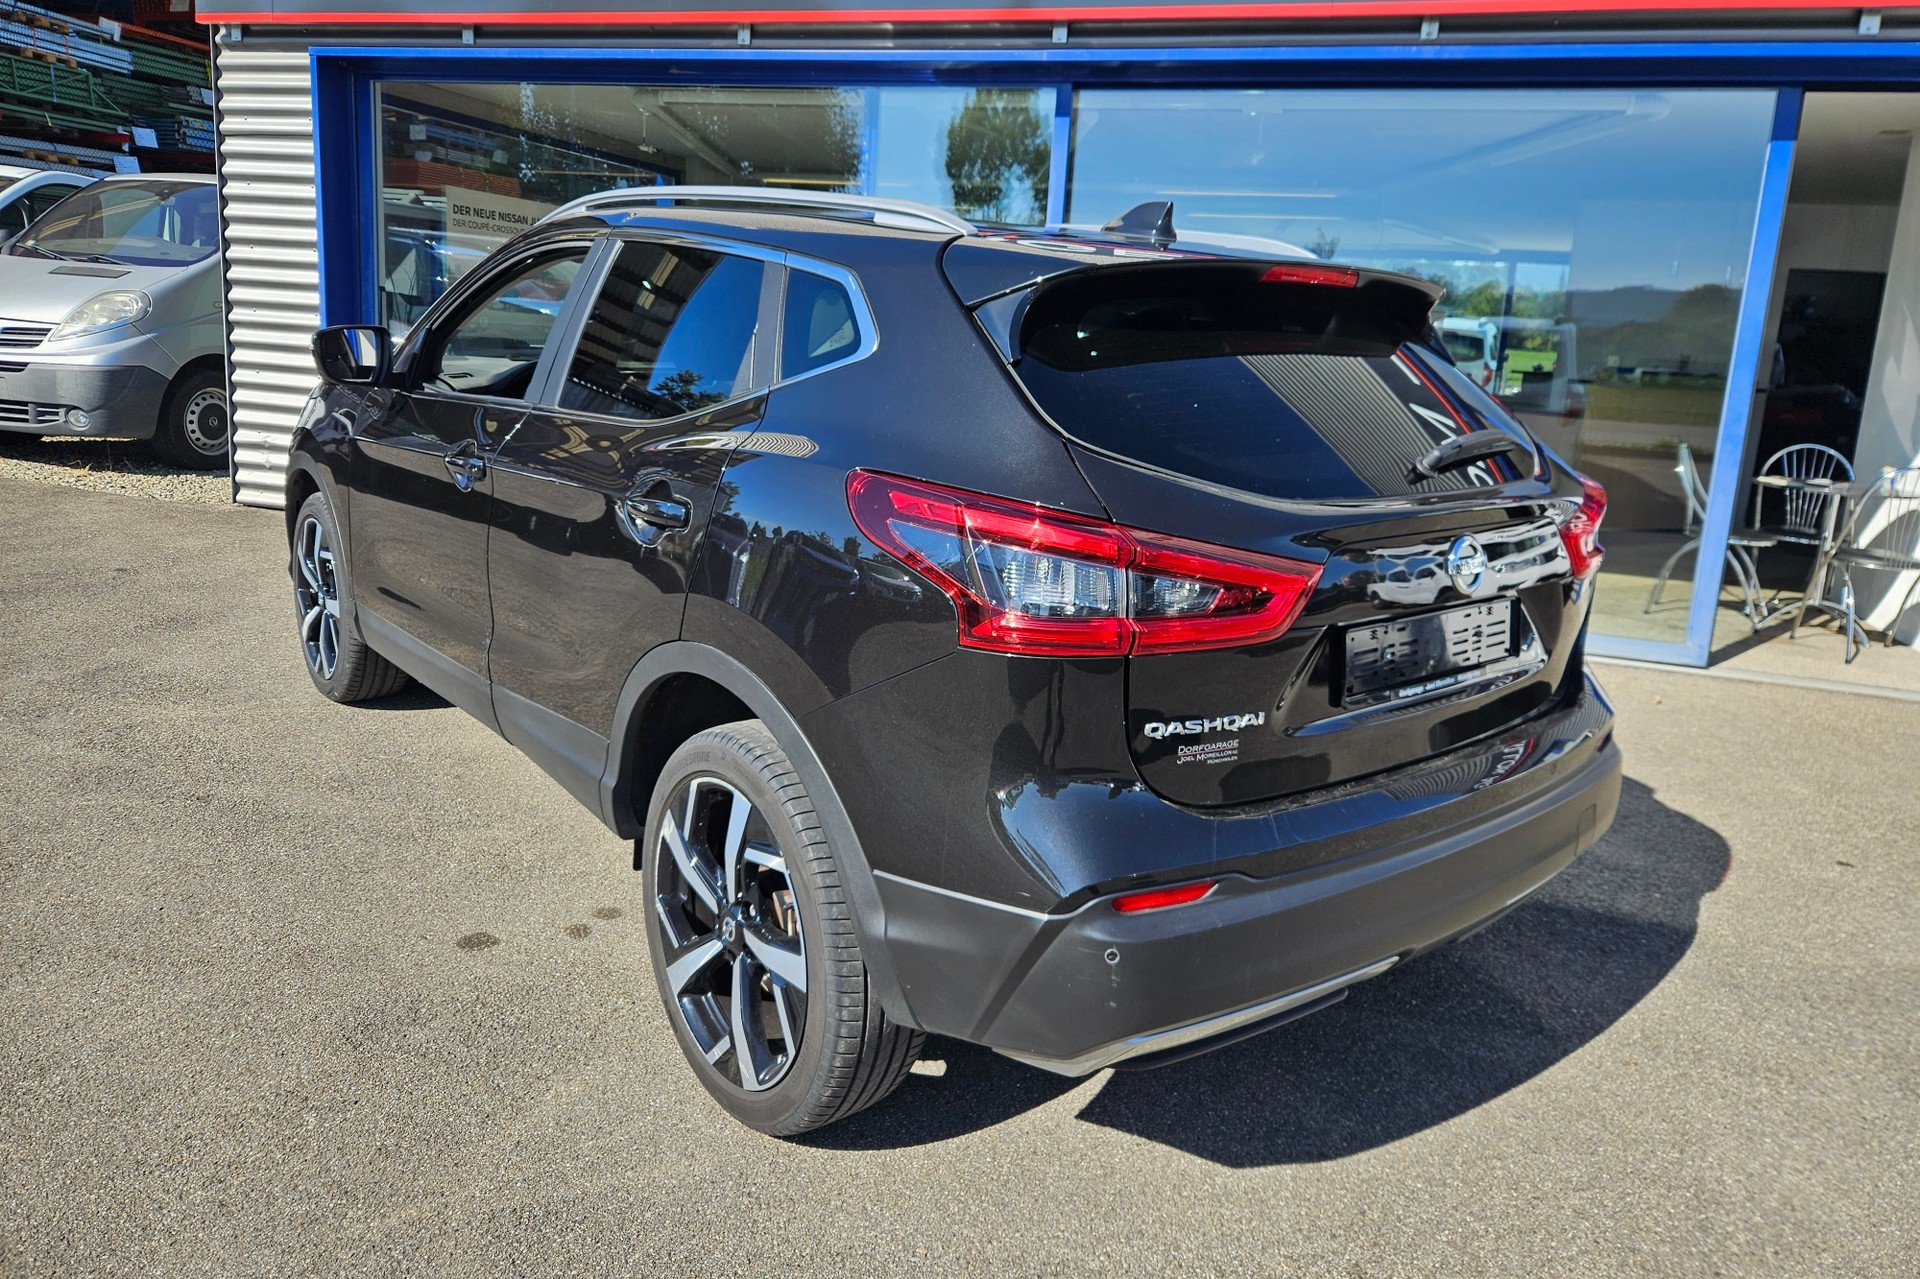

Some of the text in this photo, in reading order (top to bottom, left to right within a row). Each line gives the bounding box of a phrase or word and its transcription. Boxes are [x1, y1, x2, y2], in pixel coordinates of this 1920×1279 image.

[452, 203, 471, 217] DER
[472, 207, 496, 221] NEUE
[498, 211, 528, 225] NISSAN
[452, 218, 467, 228] DER
[1144, 711, 1265, 739] QASHQAI
